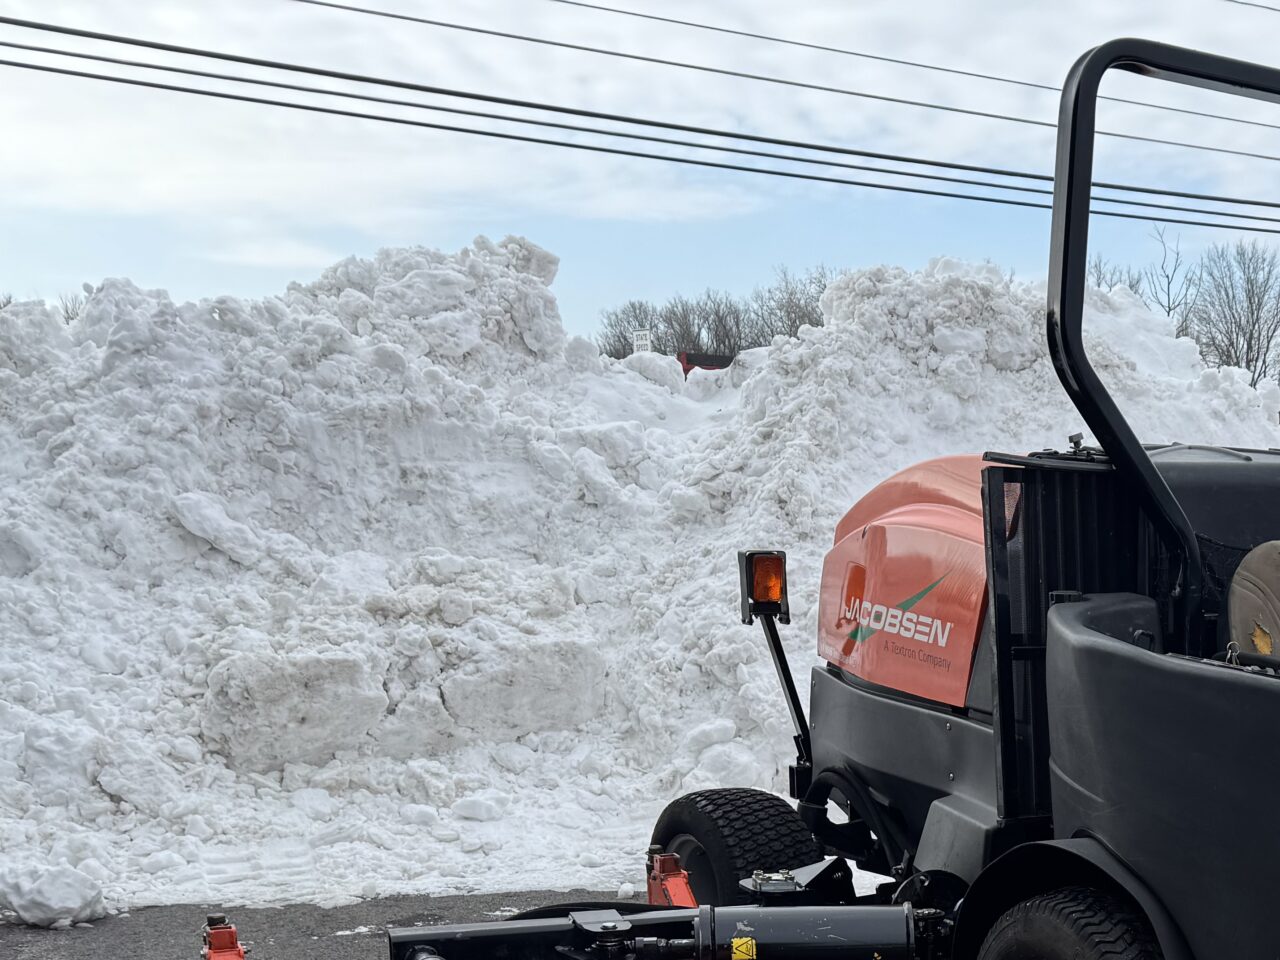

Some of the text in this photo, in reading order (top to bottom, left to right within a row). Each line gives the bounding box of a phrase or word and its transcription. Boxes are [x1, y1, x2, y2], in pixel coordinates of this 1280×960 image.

[635, 334, 648, 342] STATE
[845, 596, 951, 647] JACOBSEN
[892, 642, 917, 659] Textron
[917, 649, 951, 672] Company
